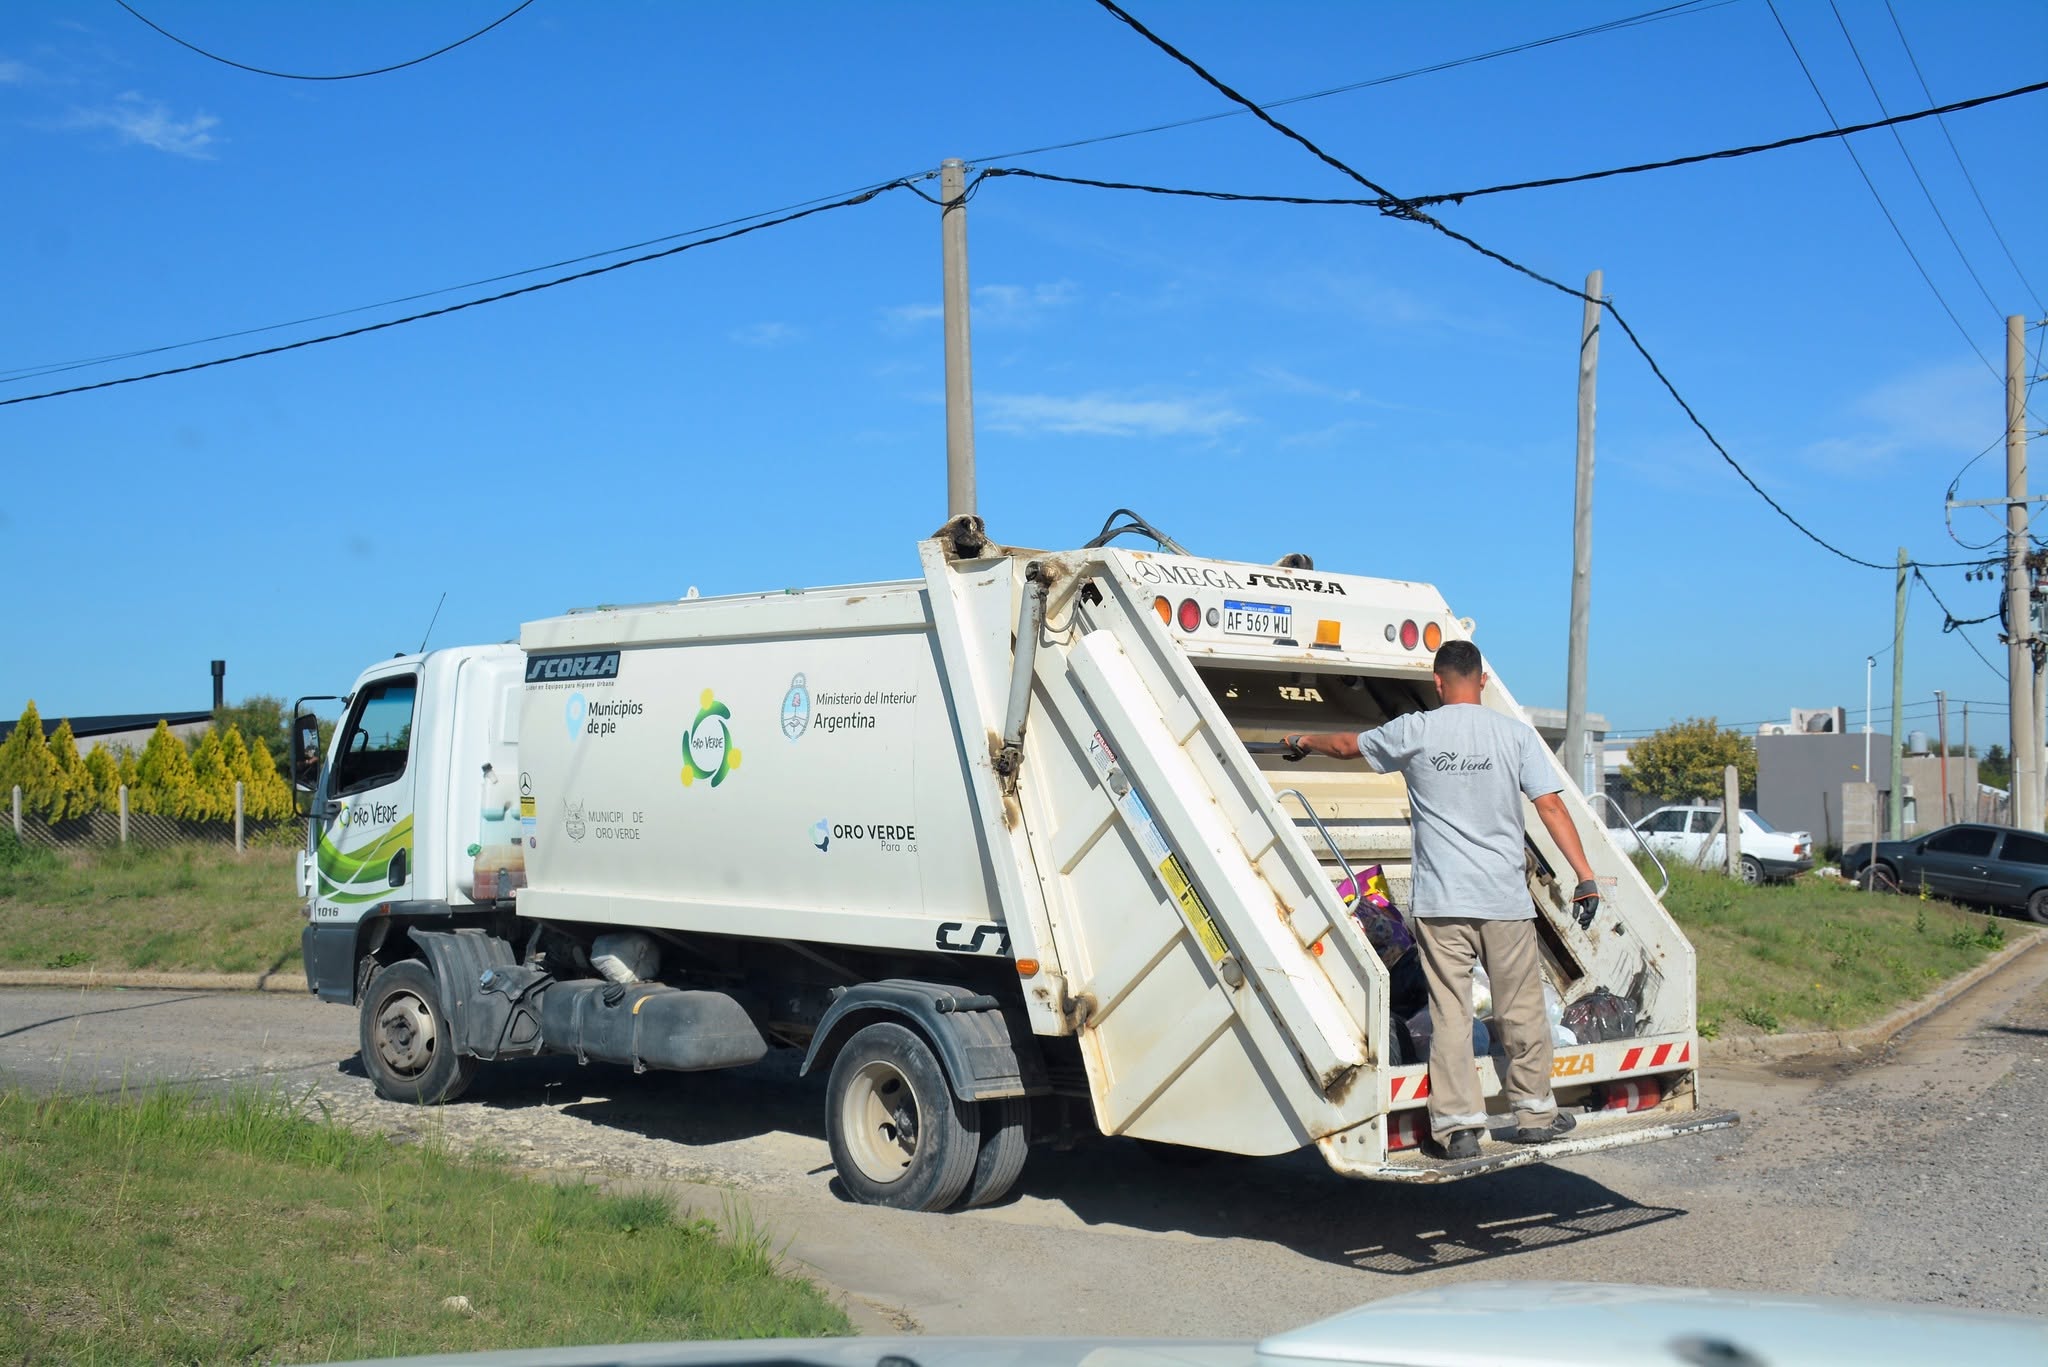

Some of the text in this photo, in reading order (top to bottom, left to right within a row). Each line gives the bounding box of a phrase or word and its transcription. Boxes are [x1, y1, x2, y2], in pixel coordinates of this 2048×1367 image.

[1227, 611, 1243, 631] AF
[1246, 613, 1269, 633] 569
[527, 654, 619, 680] SCORZA
[816, 691, 862, 705] Ministerio
[864, 691, 879, 705] del
[588, 699, 643, 718] Municipios
[587, 718, 616, 738] de pie
[813, 711, 876, 733] Argentina
[1436, 757, 1493, 772] Oro Verde
[632, 811, 644, 823] DE
[595, 827, 641, 840] ORO VERDE
[833, 824, 916, 841] ORO VERDE
[881, 840, 901, 852] Para
[317, 907, 339, 917] 1016
